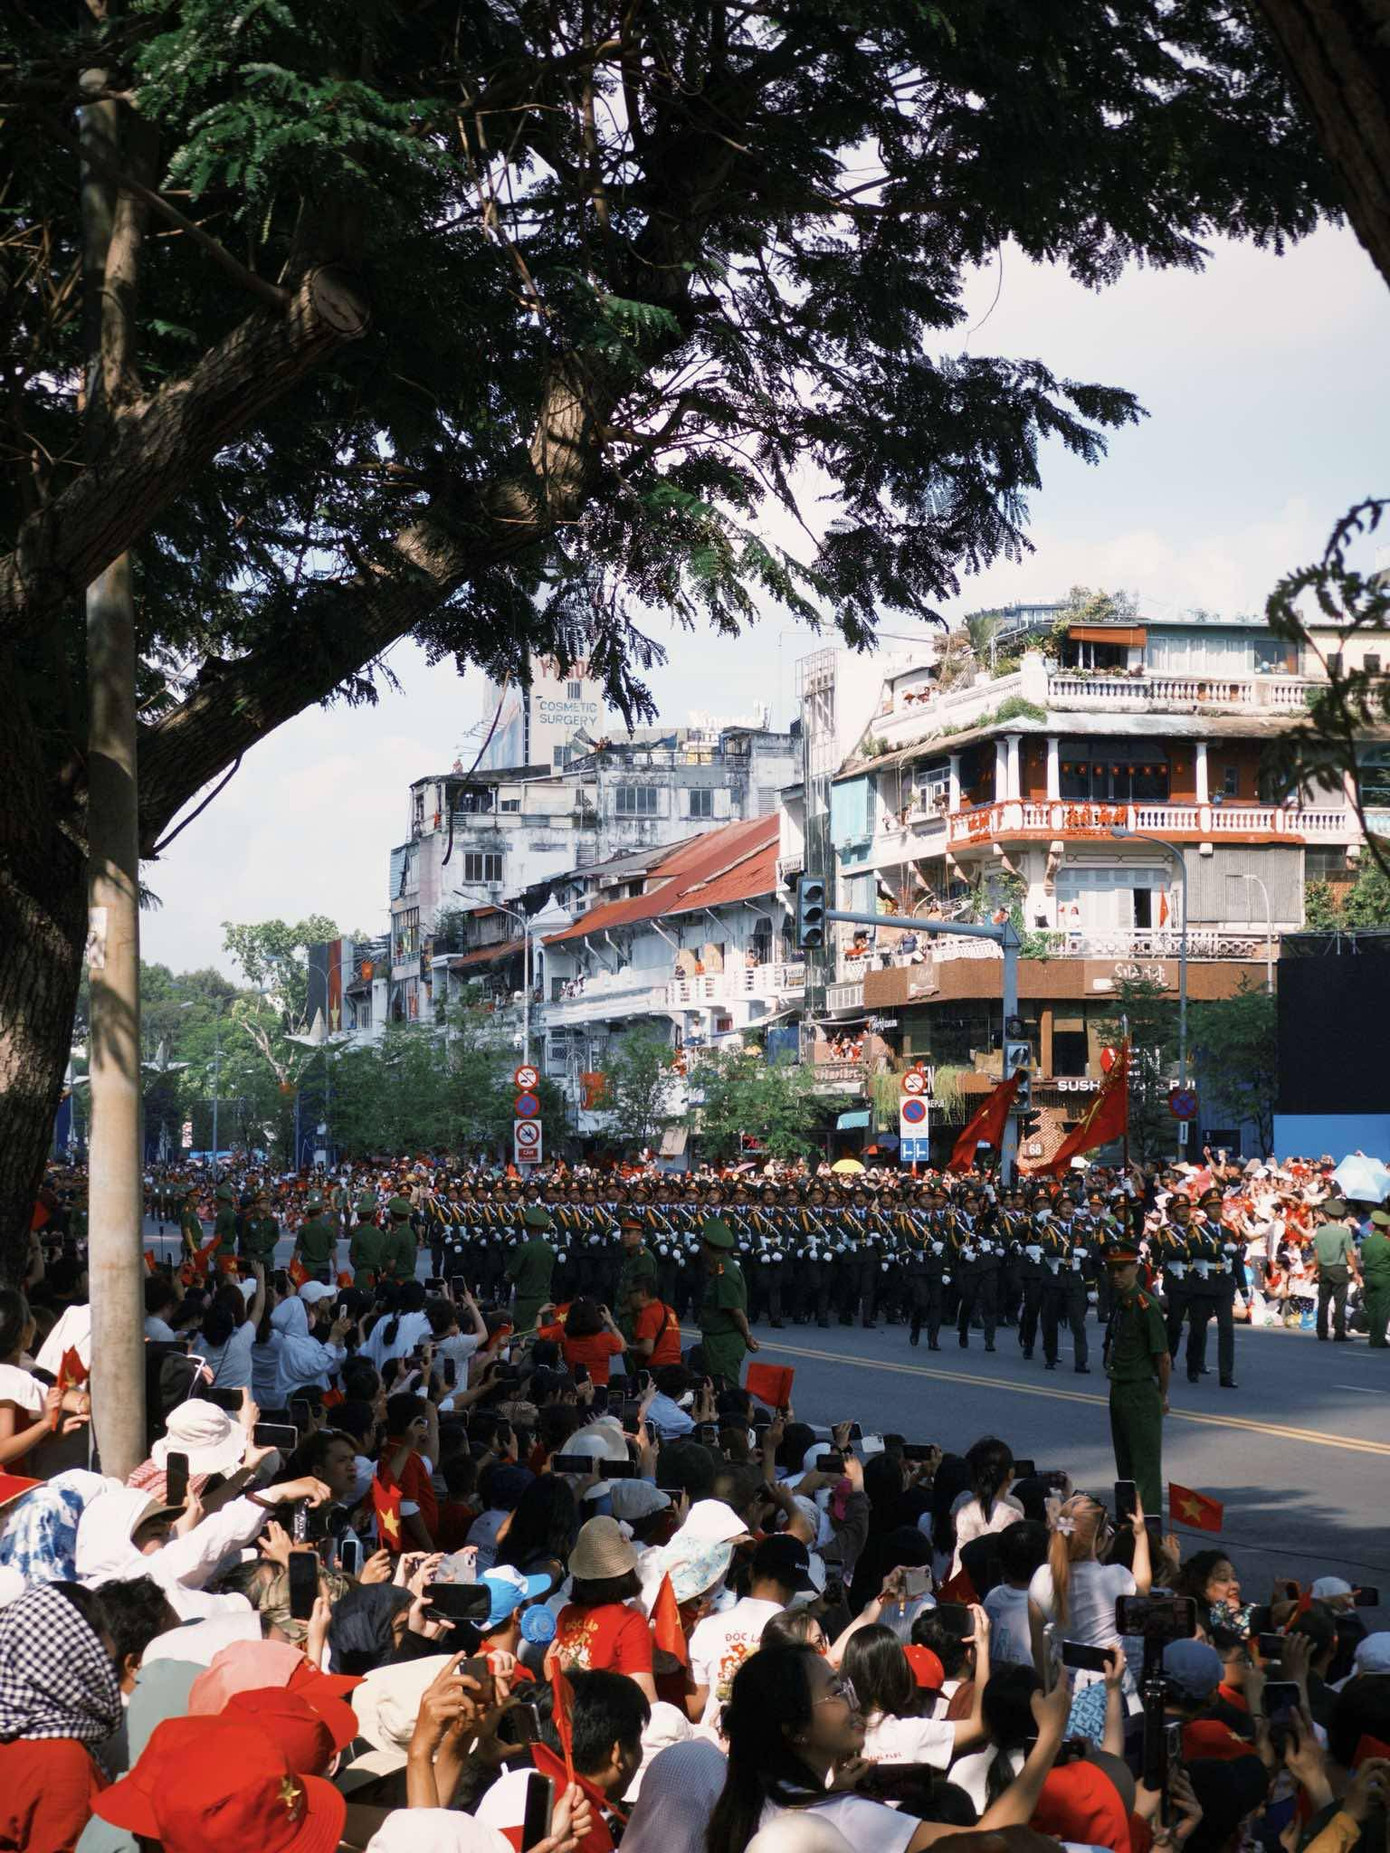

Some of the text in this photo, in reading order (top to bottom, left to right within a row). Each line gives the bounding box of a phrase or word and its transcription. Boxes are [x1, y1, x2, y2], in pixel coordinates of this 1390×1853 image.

[540, 701, 597, 713] COSMETIC
[540, 714, 597, 726] SURGERY
[1057, 1080, 1100, 1092] SUSH
[1029, 1143, 1042, 1155] 68
